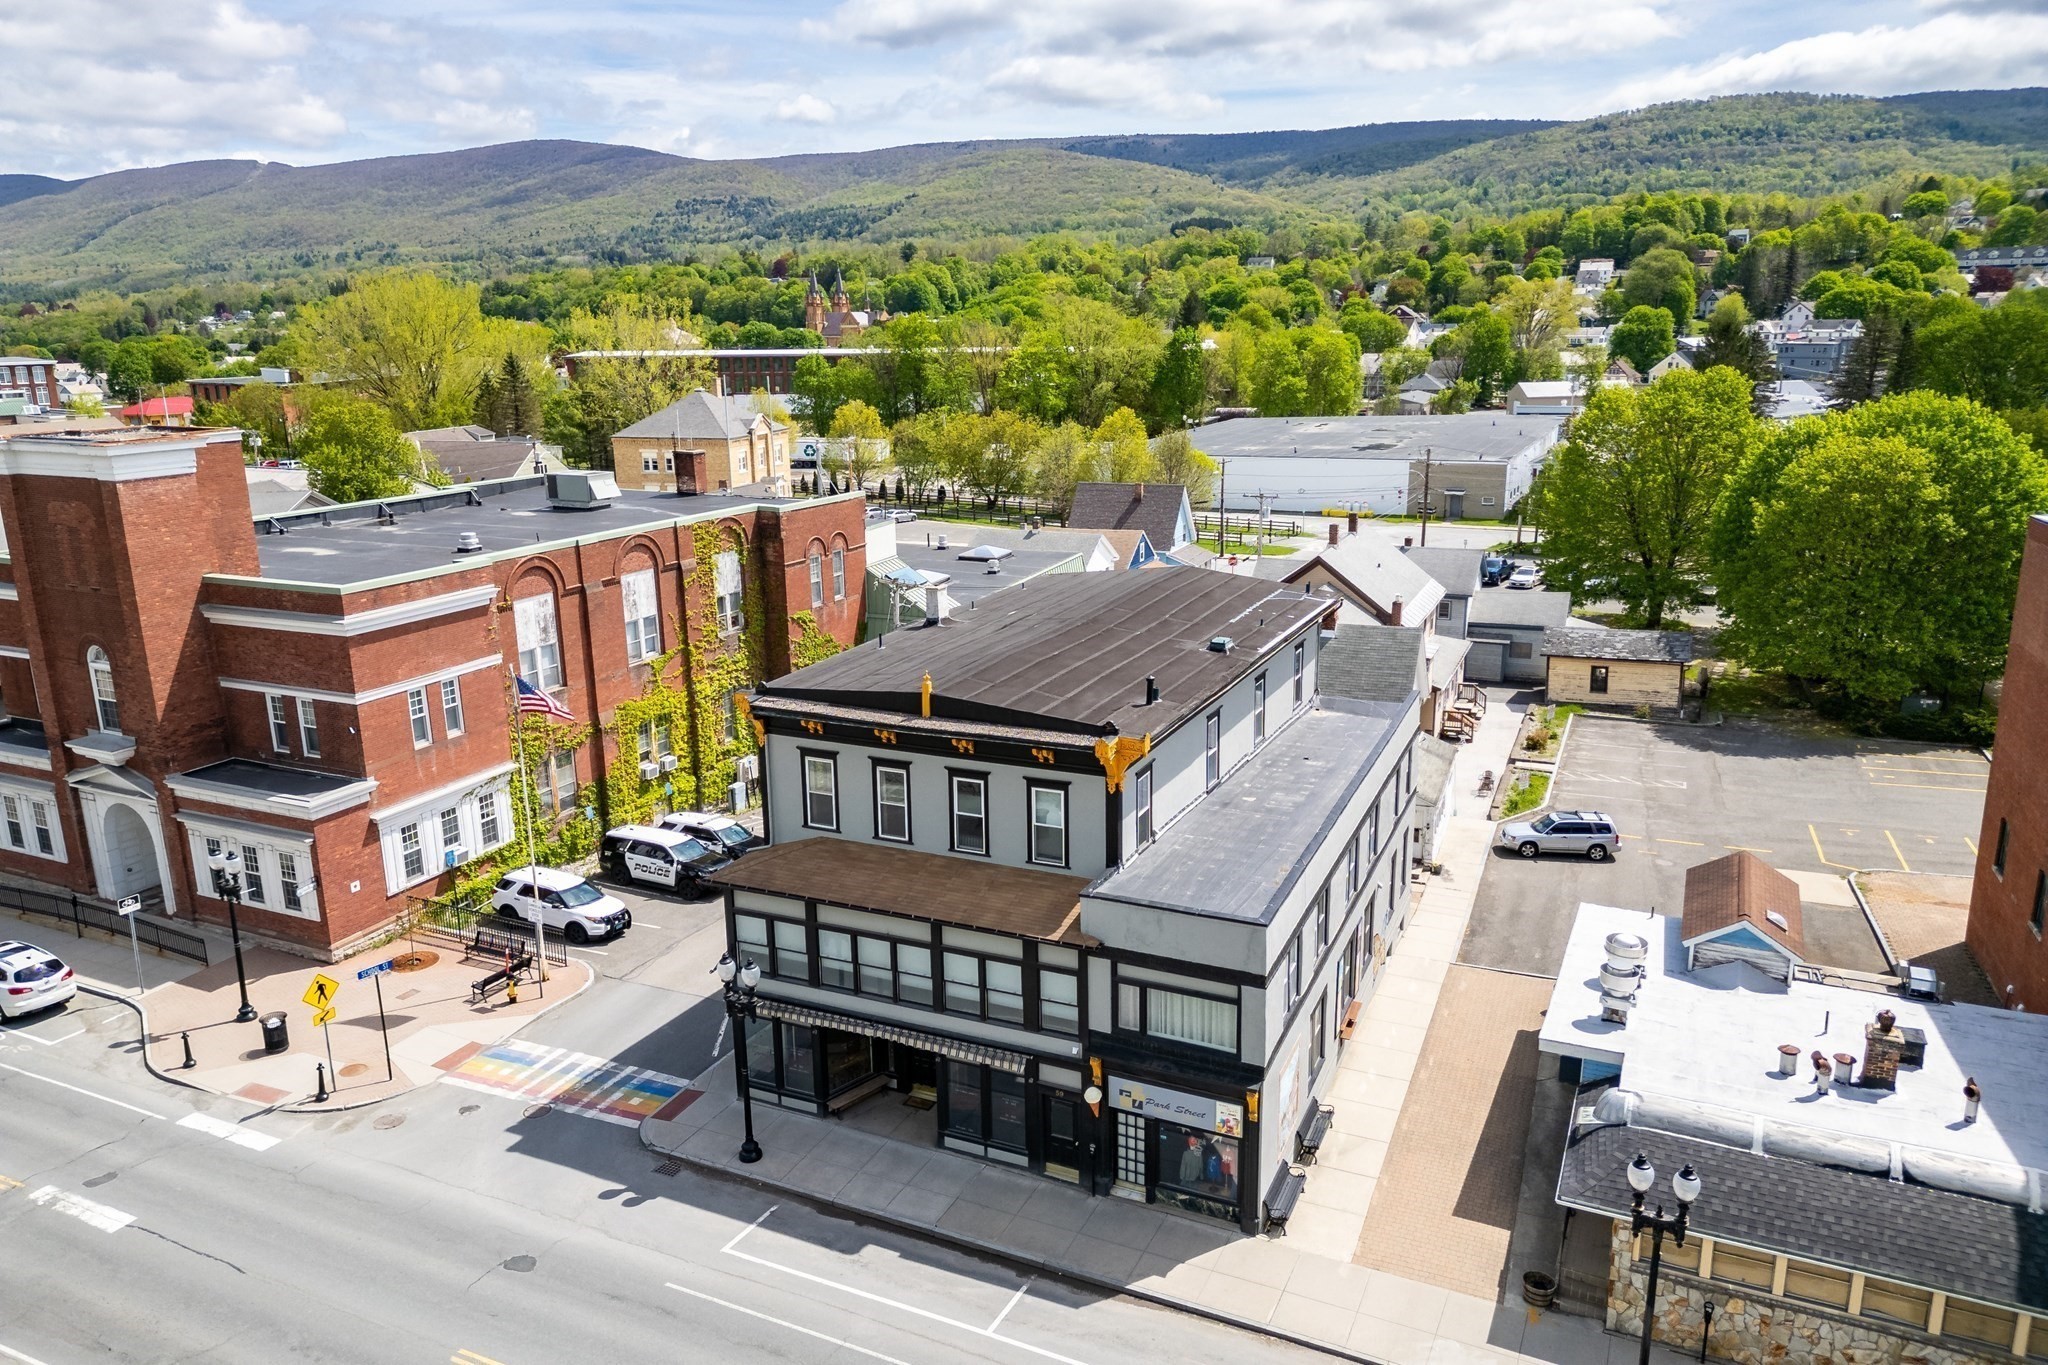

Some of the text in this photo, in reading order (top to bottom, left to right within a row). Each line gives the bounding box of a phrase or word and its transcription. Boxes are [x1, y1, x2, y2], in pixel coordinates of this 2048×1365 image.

[634, 863, 671, 878] POLICE
[1144, 1097, 1171, 1111] Park
[1174, 1105, 1207, 1119] Street
